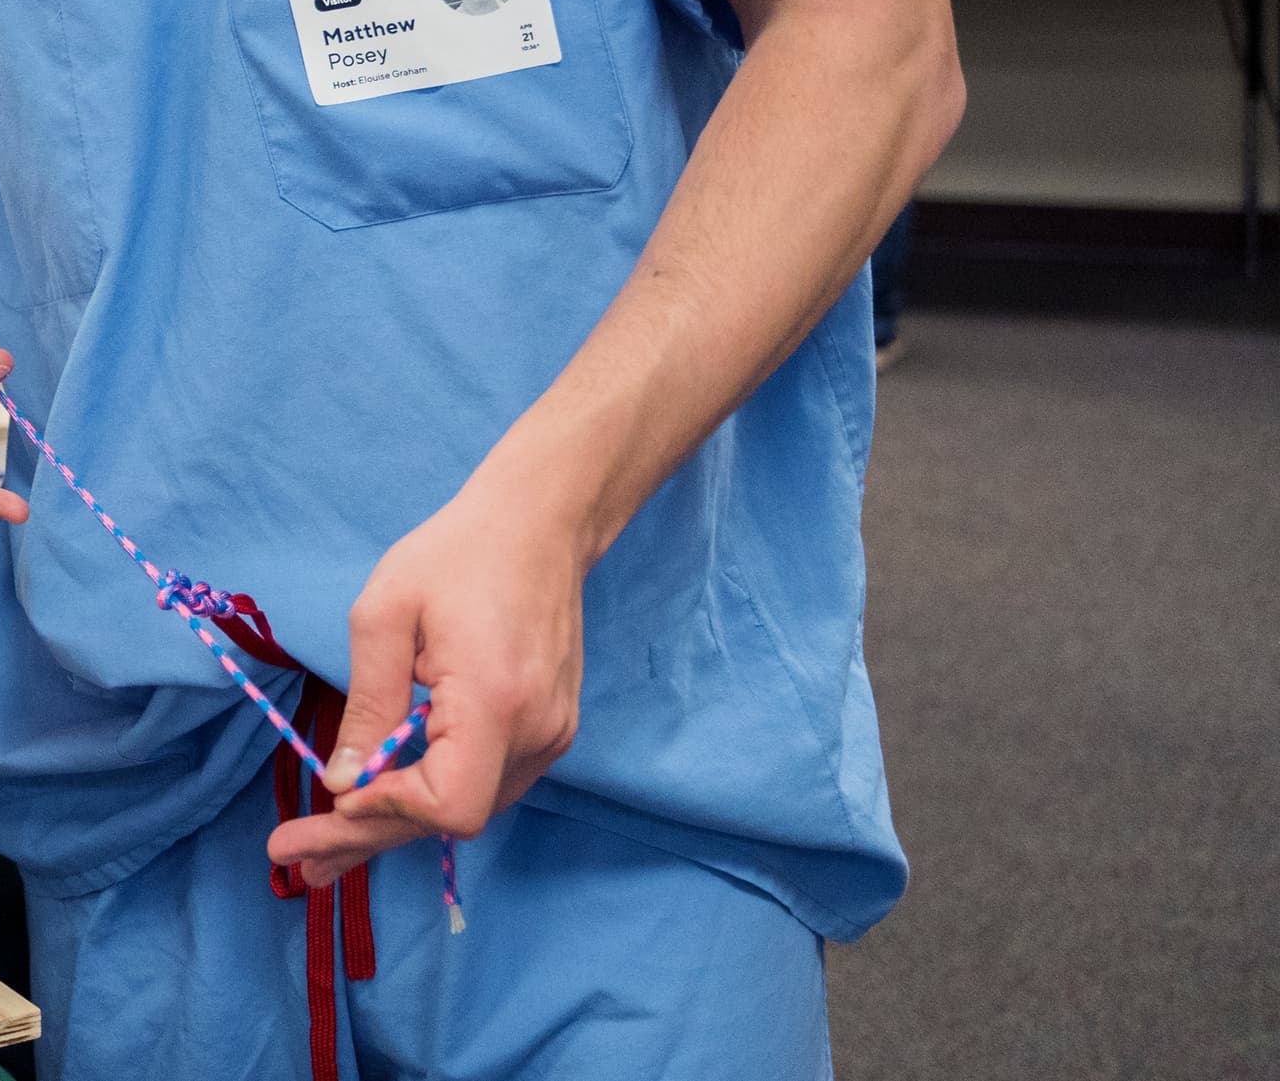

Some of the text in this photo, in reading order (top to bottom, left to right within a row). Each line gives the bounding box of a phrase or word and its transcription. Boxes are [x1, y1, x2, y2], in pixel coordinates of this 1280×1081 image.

[322, 18, 415, 46] Matthew
[522, 31, 534, 42] 21
[328, 48, 388, 70] Posey
[333, 66, 428, 90] Host: Elouise Graham
